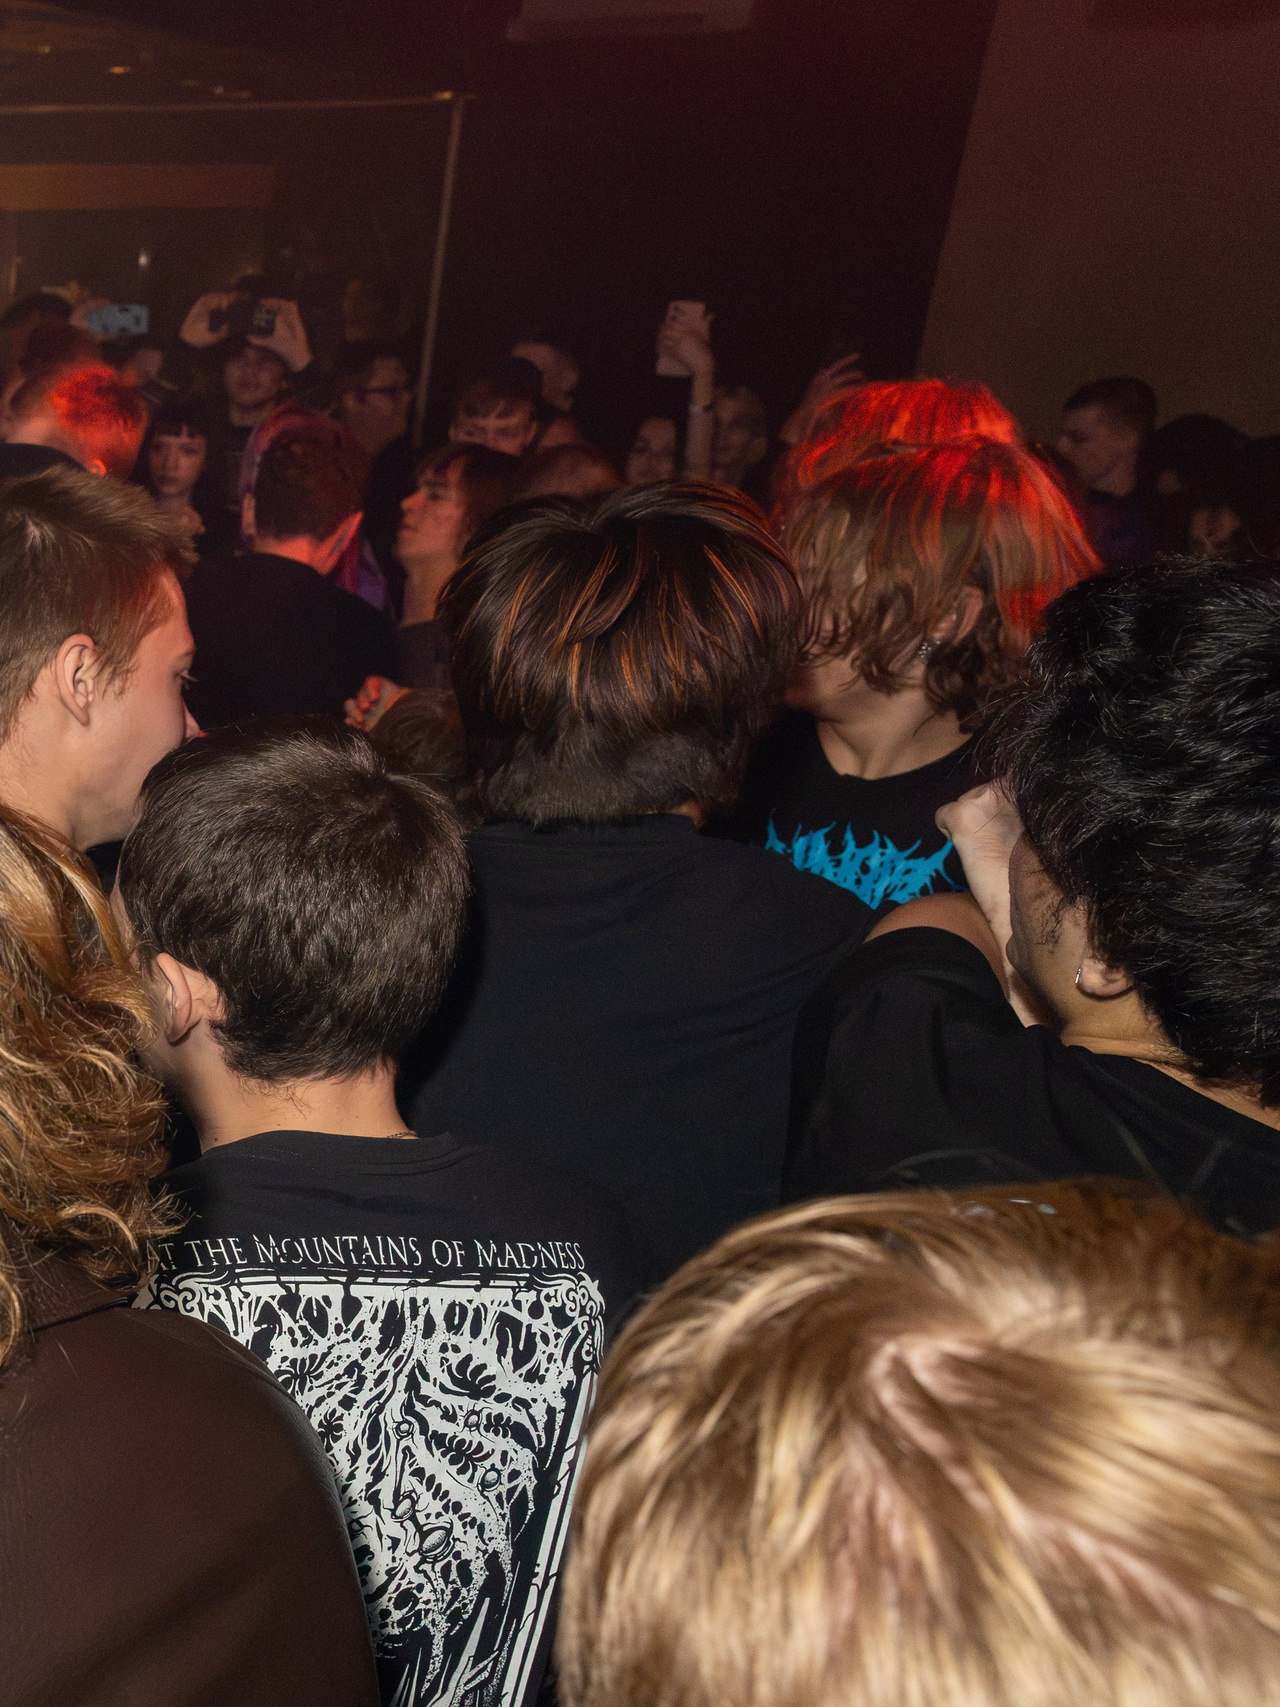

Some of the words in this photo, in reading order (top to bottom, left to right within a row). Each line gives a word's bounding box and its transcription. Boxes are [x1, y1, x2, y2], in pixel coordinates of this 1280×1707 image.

[184, 1237, 248, 1268] THE
[252, 1233, 422, 1266] MOUNTAINS
[431, 1239, 466, 1268] OF
[473, 1239, 586, 1270] MADNESS
